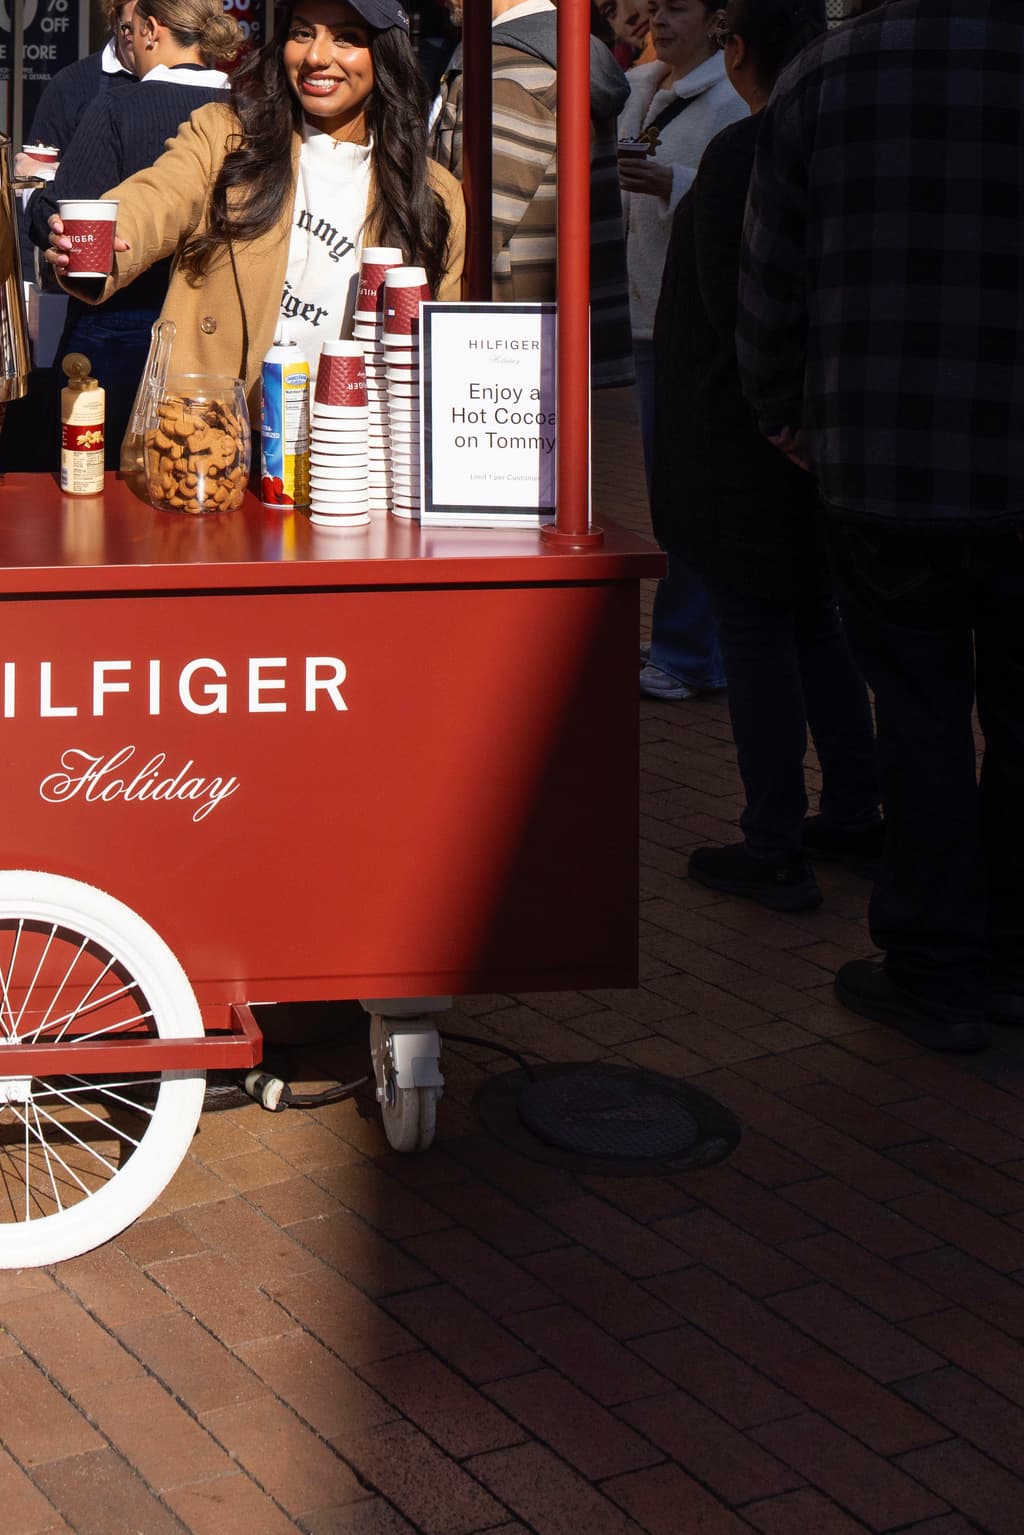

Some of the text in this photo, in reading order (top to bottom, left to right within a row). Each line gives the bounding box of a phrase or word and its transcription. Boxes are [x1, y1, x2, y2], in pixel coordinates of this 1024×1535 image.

[40, 17, 70, 33] OFF
[22, 45, 57, 60] TORE
[468, 339, 541, 351] HILFIGER
[469, 382, 541, 404] Enjoy a
[452, 407, 557, 425] Hot Cocoa
[454, 432, 557, 454] on Tommy
[39, 745, 241, 823] Holiday
